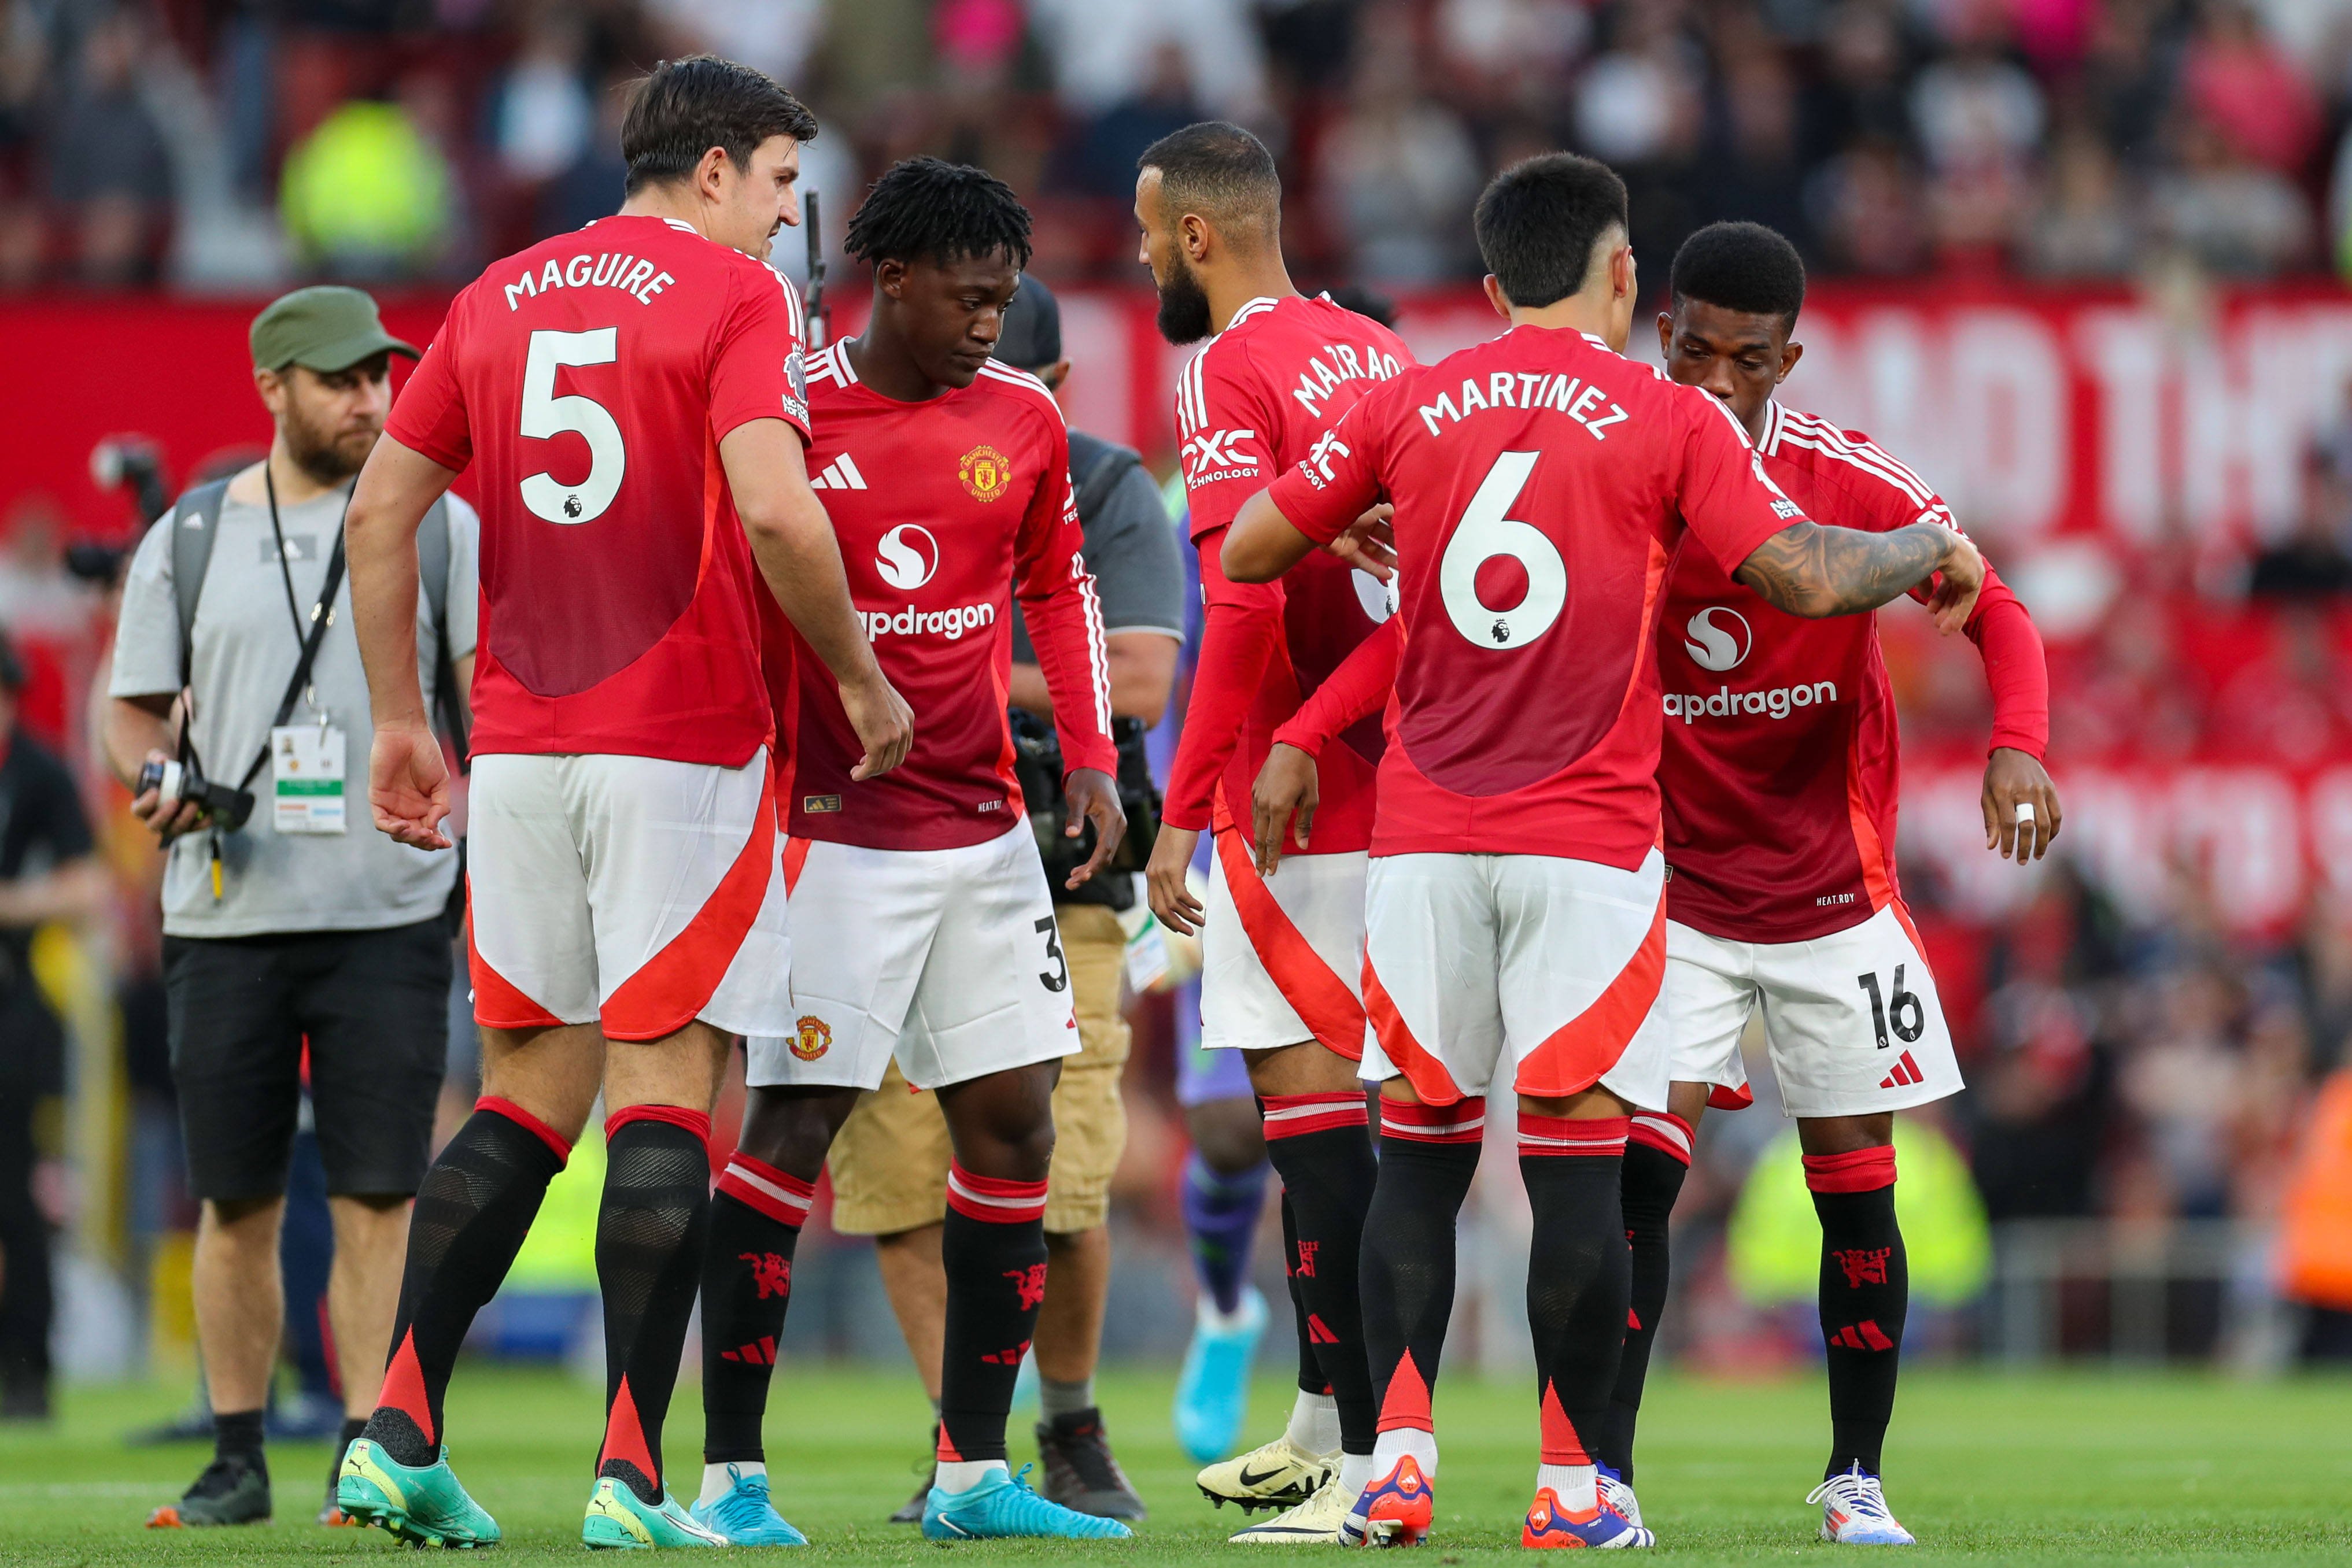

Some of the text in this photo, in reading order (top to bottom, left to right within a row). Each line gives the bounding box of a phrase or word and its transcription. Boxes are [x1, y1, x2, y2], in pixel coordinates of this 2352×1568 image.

[504, 253, 676, 312] MAGUIRE
[1293, 343, 1405, 419] MAZRAO
[1419, 372, 1630, 441] MARTINEZ
[519, 326, 626, 525] 5
[972, 488, 1000, 498] UNITED
[1190, 468, 1259, 493] CHNOLOGY
[1439, 450, 1568, 650] 6
[1816, 893, 1854, 907] HEAT.RDY
[1034, 914, 1066, 992] 3
[1858, 963, 1924, 1049] 16
